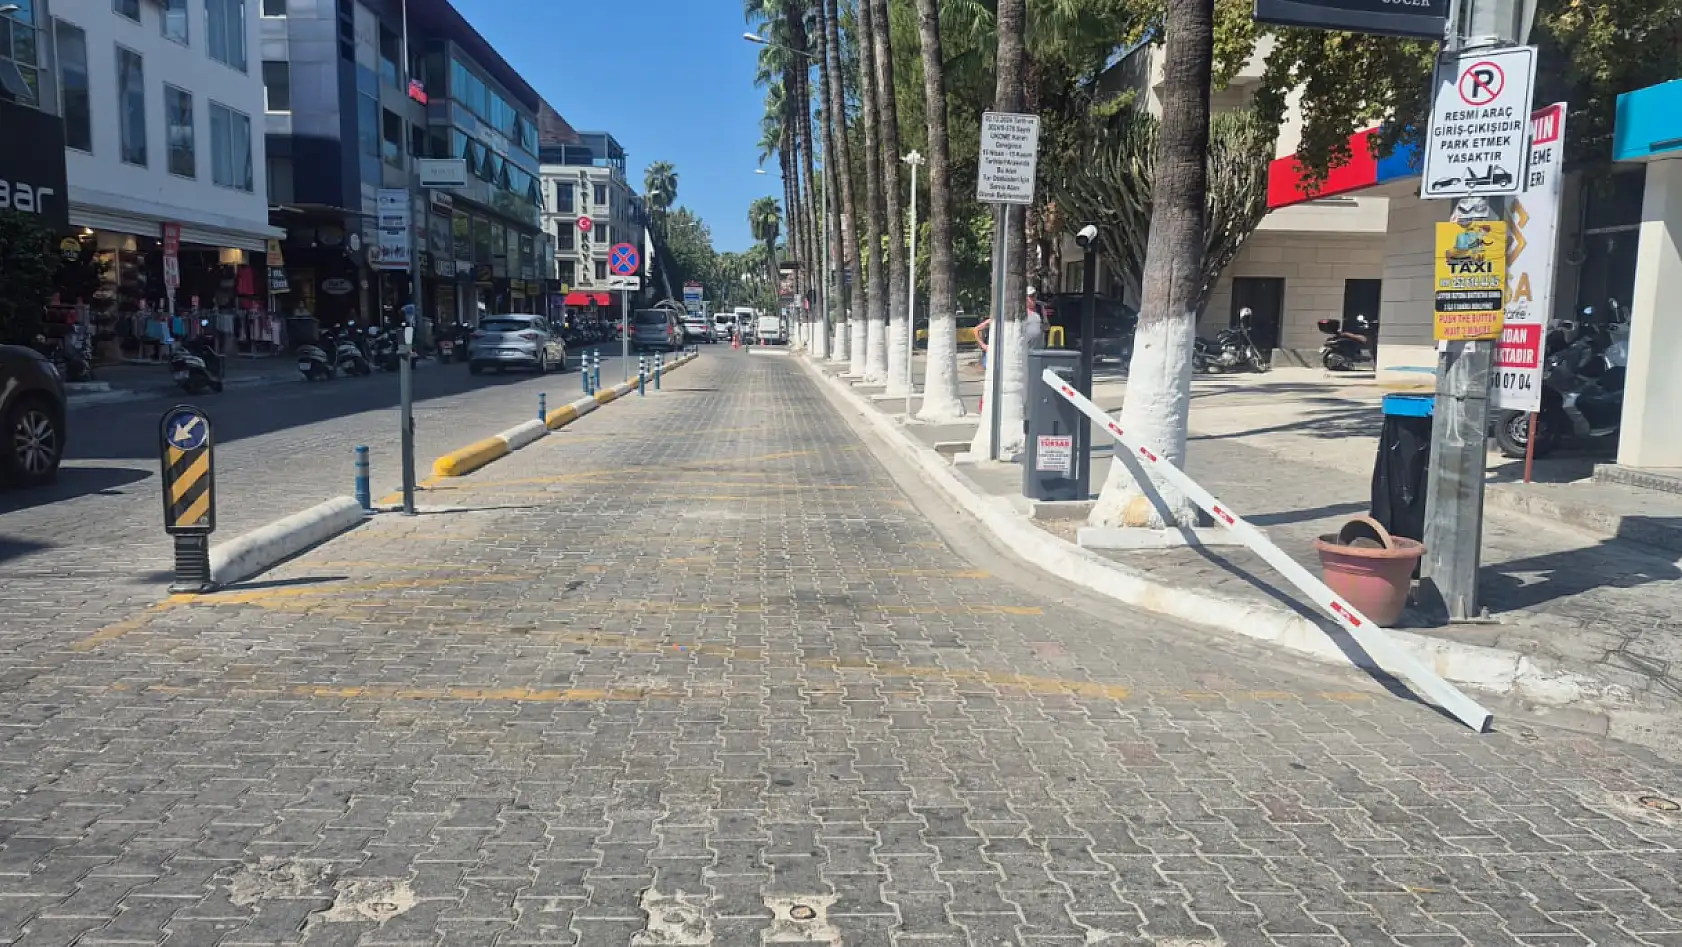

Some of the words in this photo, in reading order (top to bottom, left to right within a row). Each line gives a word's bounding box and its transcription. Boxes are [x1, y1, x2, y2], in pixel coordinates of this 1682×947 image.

[1445, 107, 1479, 121] RESMİ
[1481, 106, 1513, 119] ARAÇ
[1440, 139, 1470, 150] PARK
[1472, 136, 1512, 148] ETMEK
[1447, 151, 1502, 163] YASAKTIR
[1447, 261, 1493, 274] TAXI
